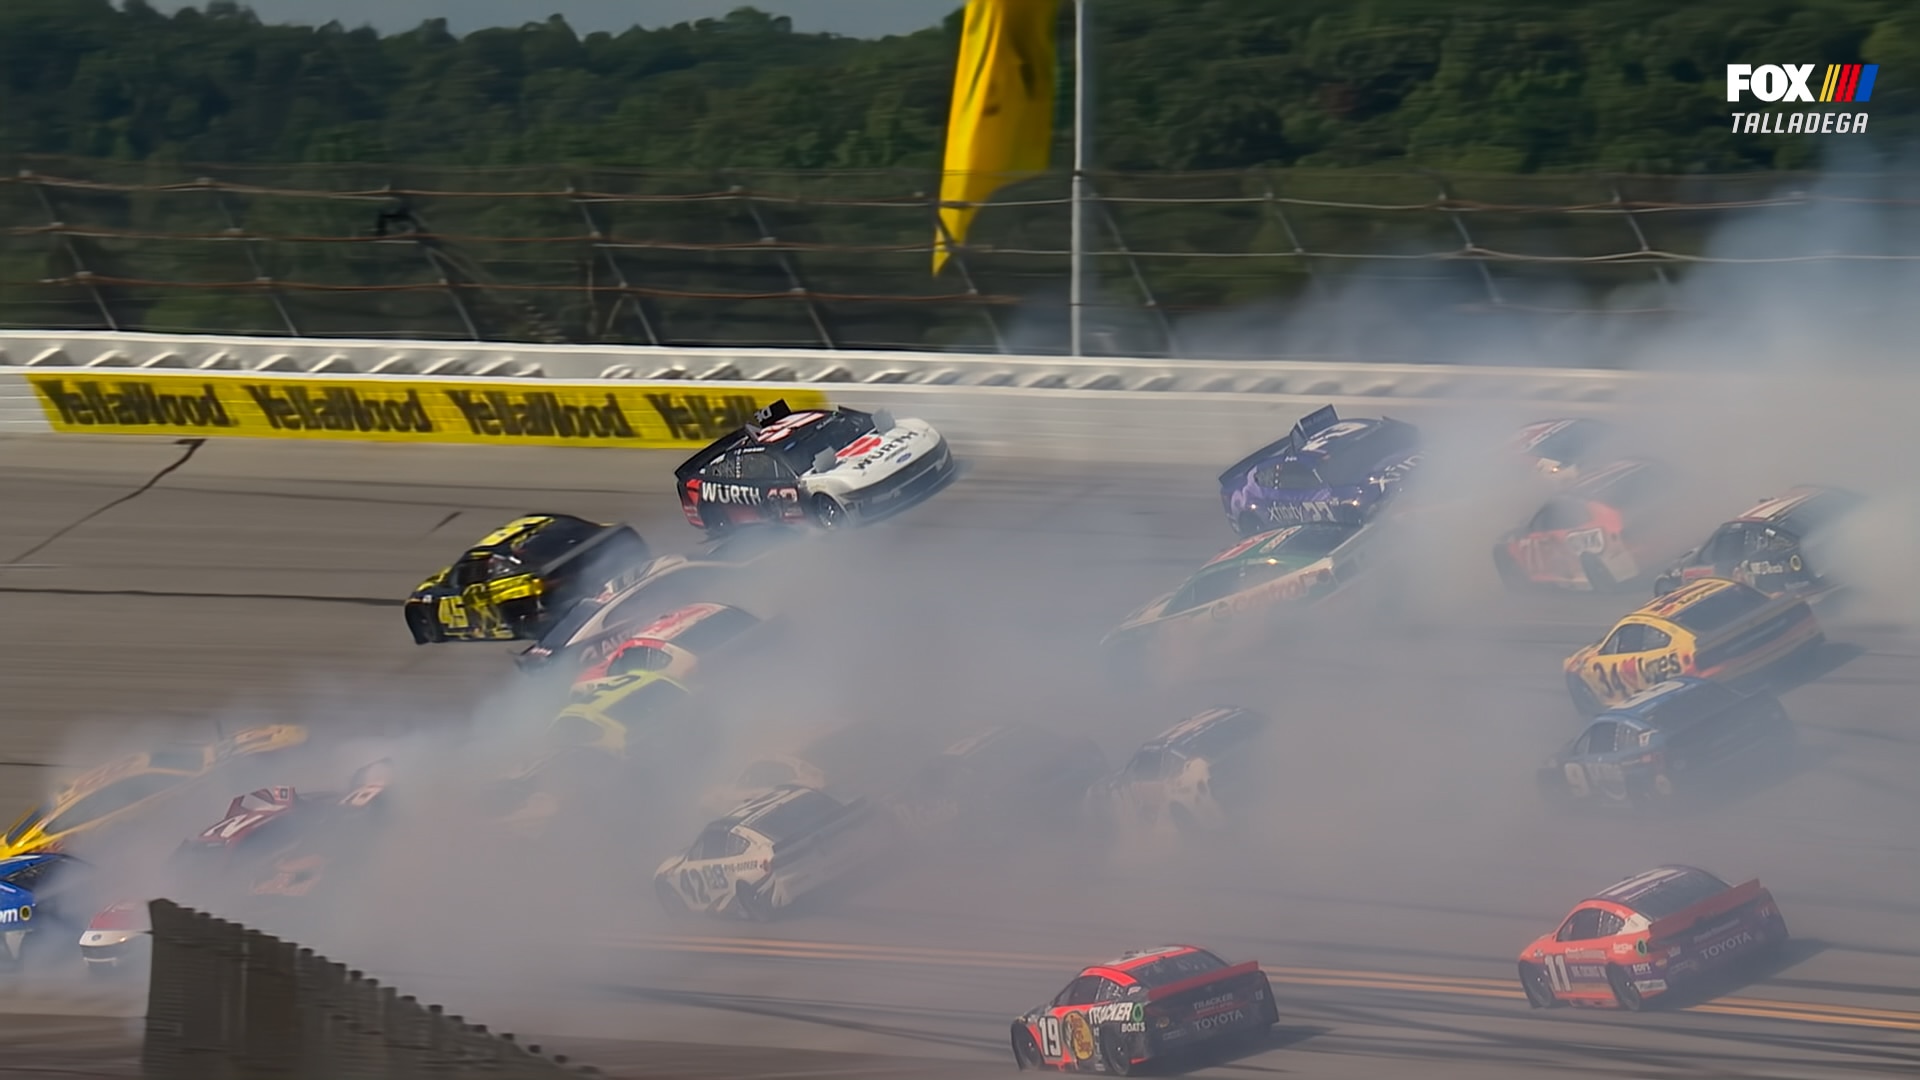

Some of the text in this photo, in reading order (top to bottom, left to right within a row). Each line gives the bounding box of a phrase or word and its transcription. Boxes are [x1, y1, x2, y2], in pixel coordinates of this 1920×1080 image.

[1267, 501, 1304, 522] xfinity
[438, 595, 468, 628] 45
[1593, 662, 1632, 699] 34
[1699, 932, 1752, 960] TOYOTA
[1545, 954, 1572, 992] 11
[1089, 1002, 1134, 1025] TRACKER
[1121, 1022, 1146, 1033] BOATS
[1194, 1010, 1244, 1032] TOYOTA
[1038, 1017, 1062, 1056] 19
